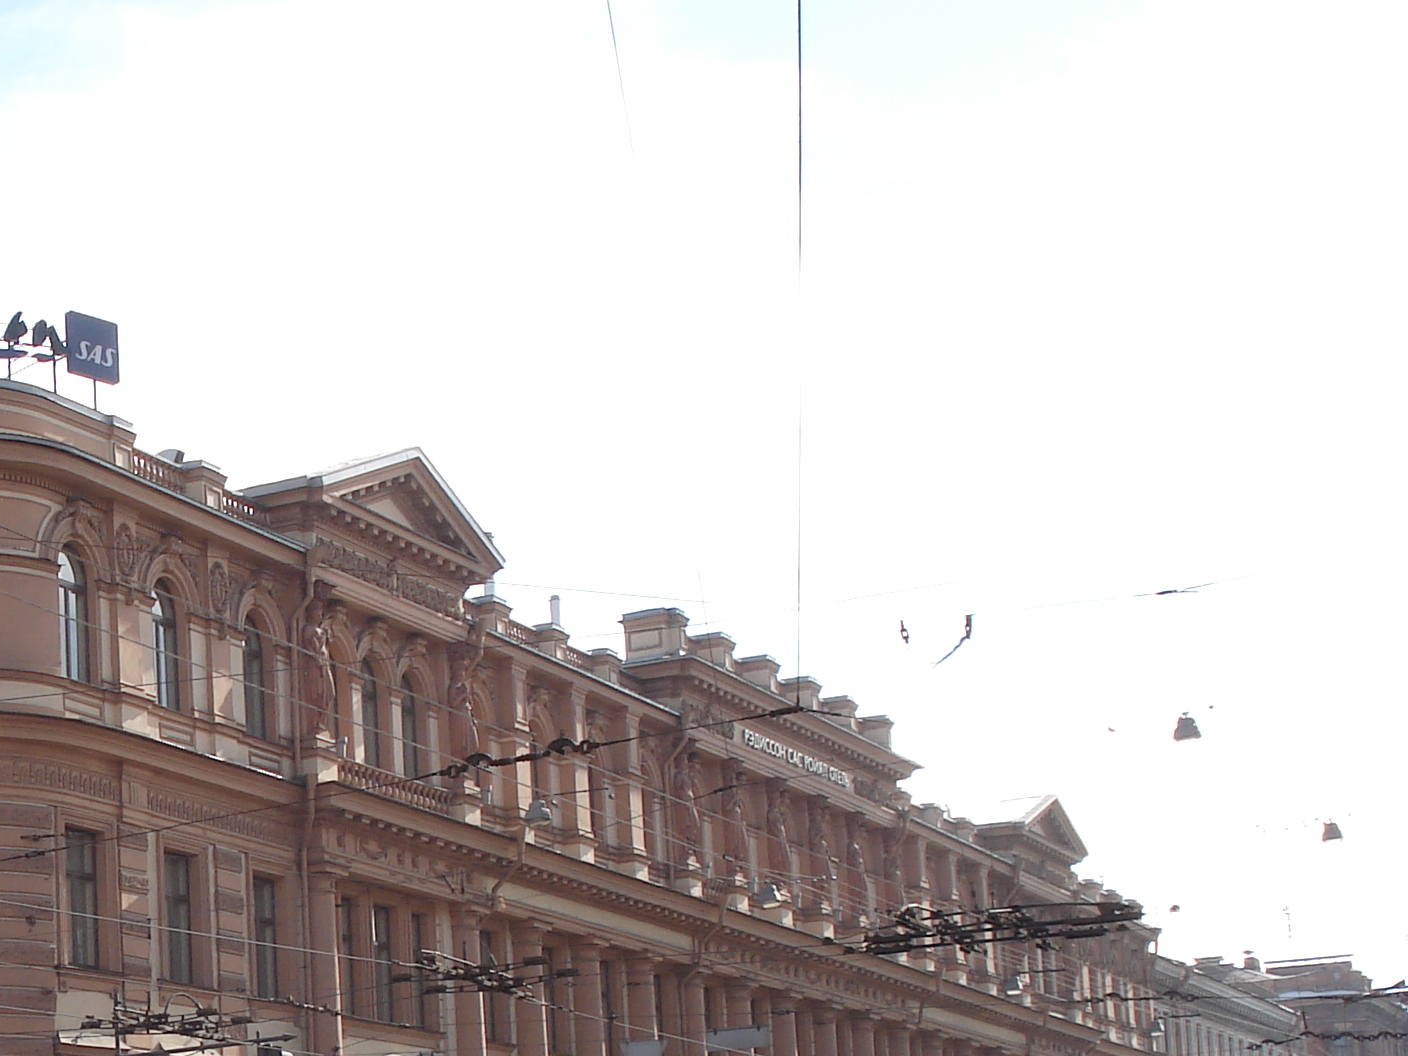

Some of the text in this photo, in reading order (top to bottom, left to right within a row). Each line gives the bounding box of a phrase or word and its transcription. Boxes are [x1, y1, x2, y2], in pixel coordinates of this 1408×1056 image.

[74, 340, 117, 368] SAS
[743, 728, 787, 761] РЭДИССОН
[787, 748, 803, 768] САС
